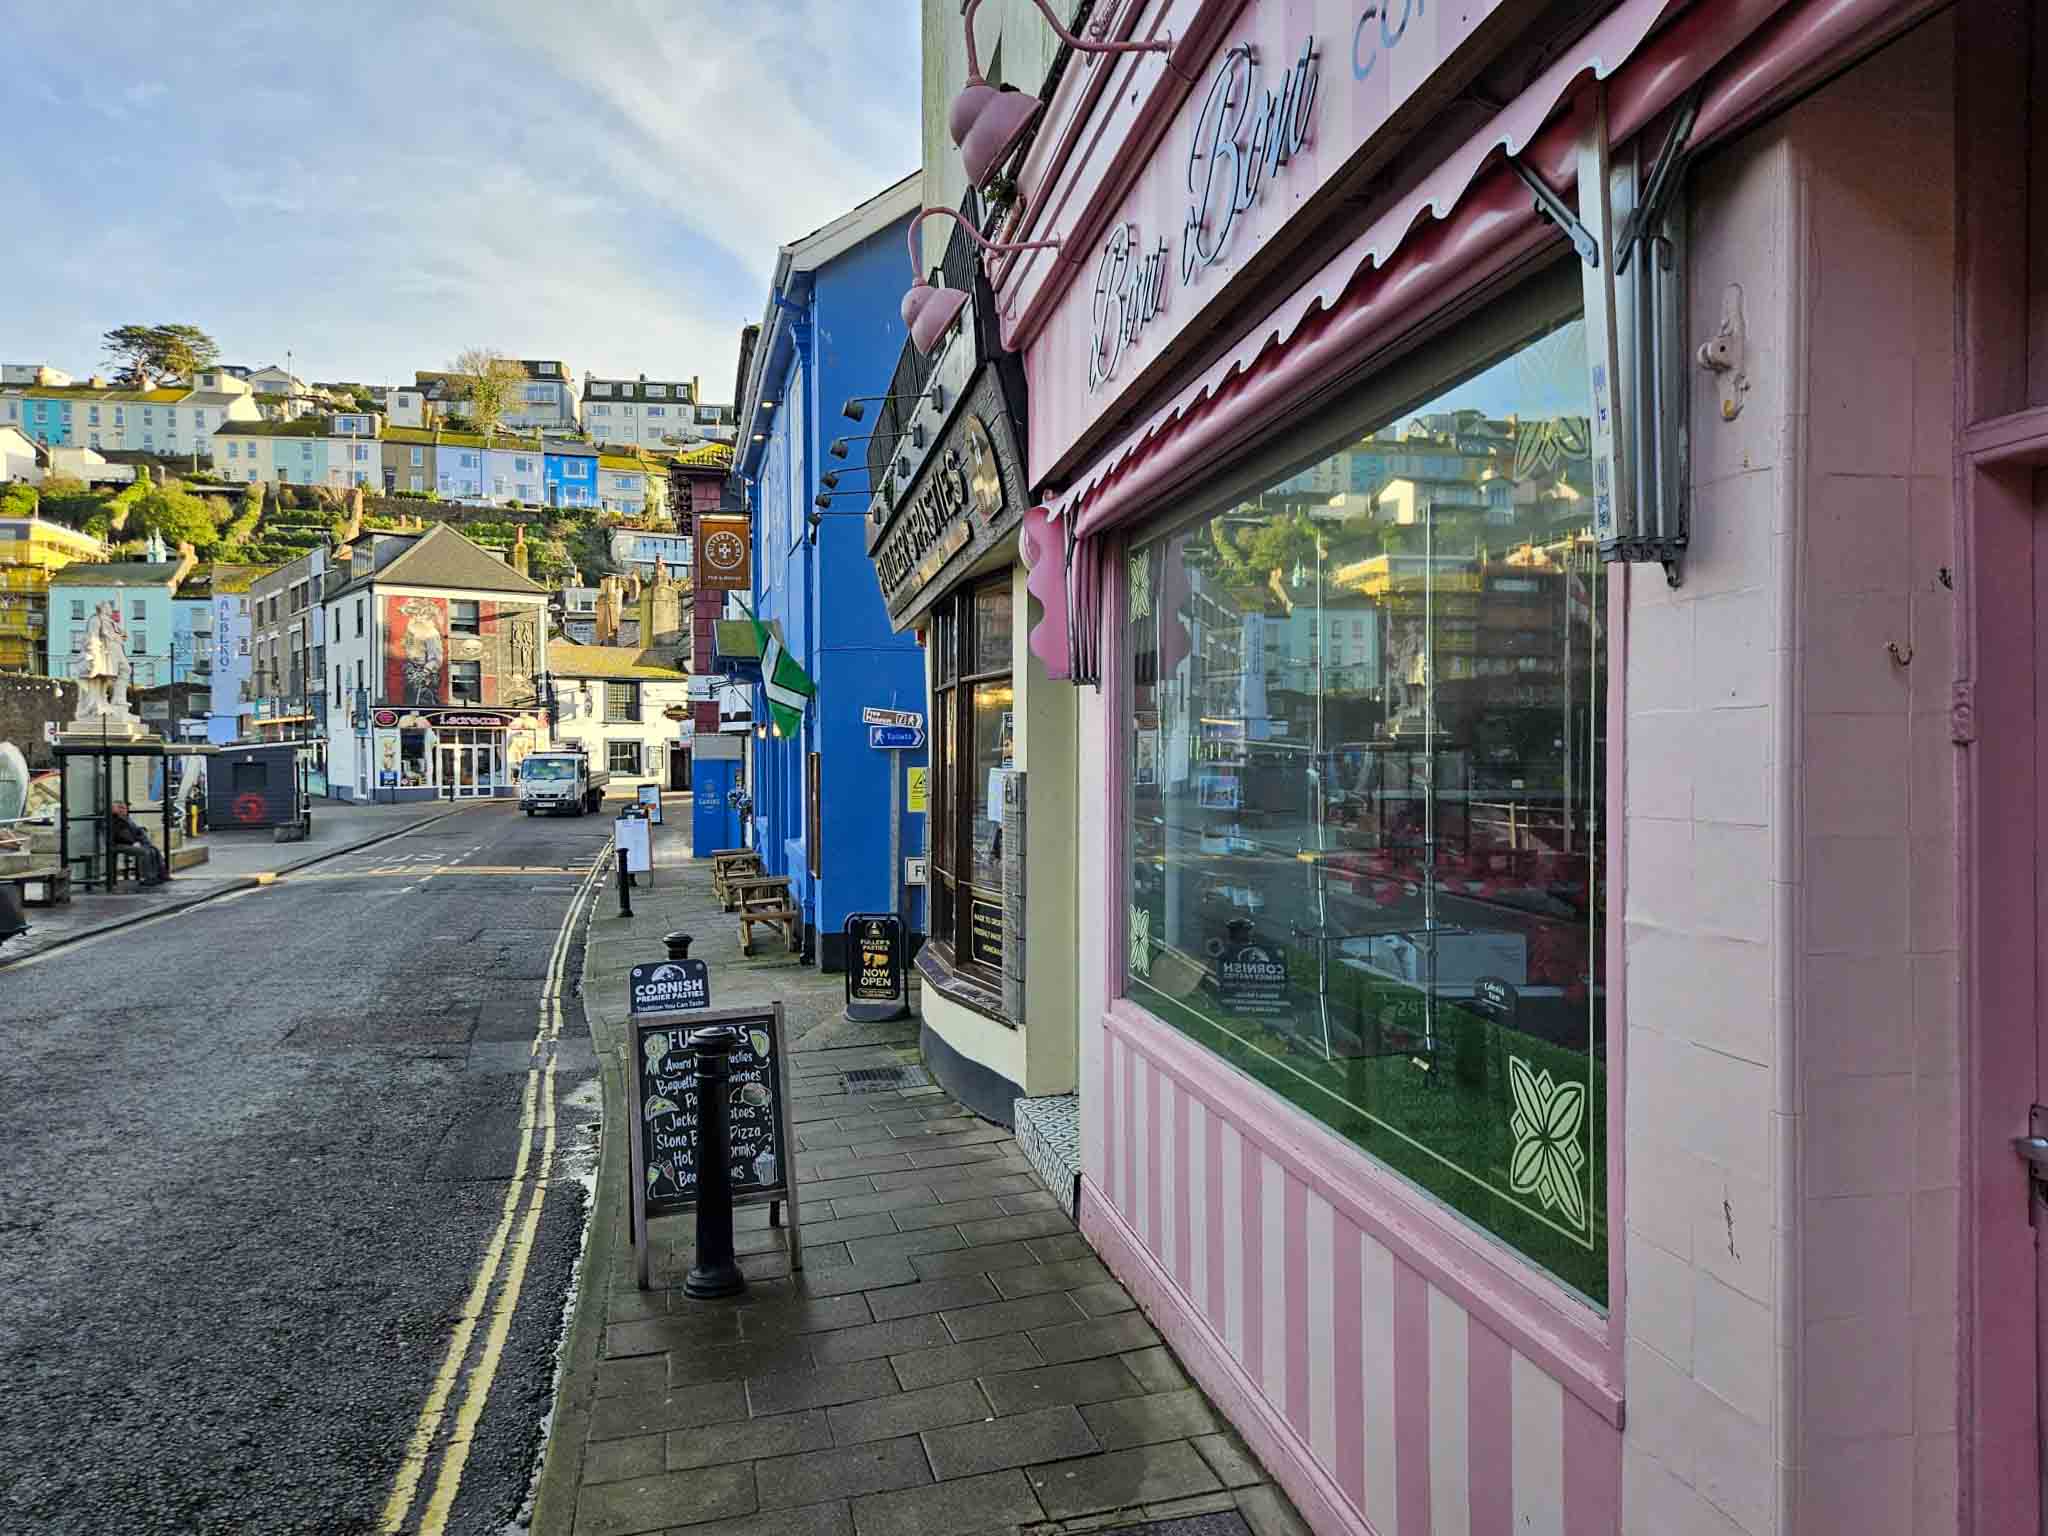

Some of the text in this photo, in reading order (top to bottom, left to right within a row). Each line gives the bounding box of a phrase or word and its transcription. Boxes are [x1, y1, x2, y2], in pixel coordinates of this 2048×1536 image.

[863, 969, 890, 978] NOW
[635, 979, 704, 996] CORNISH
[860, 977, 892, 987] OPEN
[636, 990, 705, 1003] PREMIER PASTIES
[728, 1050, 753, 1065] asties
[656, 1134, 688, 1150] Stone
[673, 1150, 694, 1168] Hot
